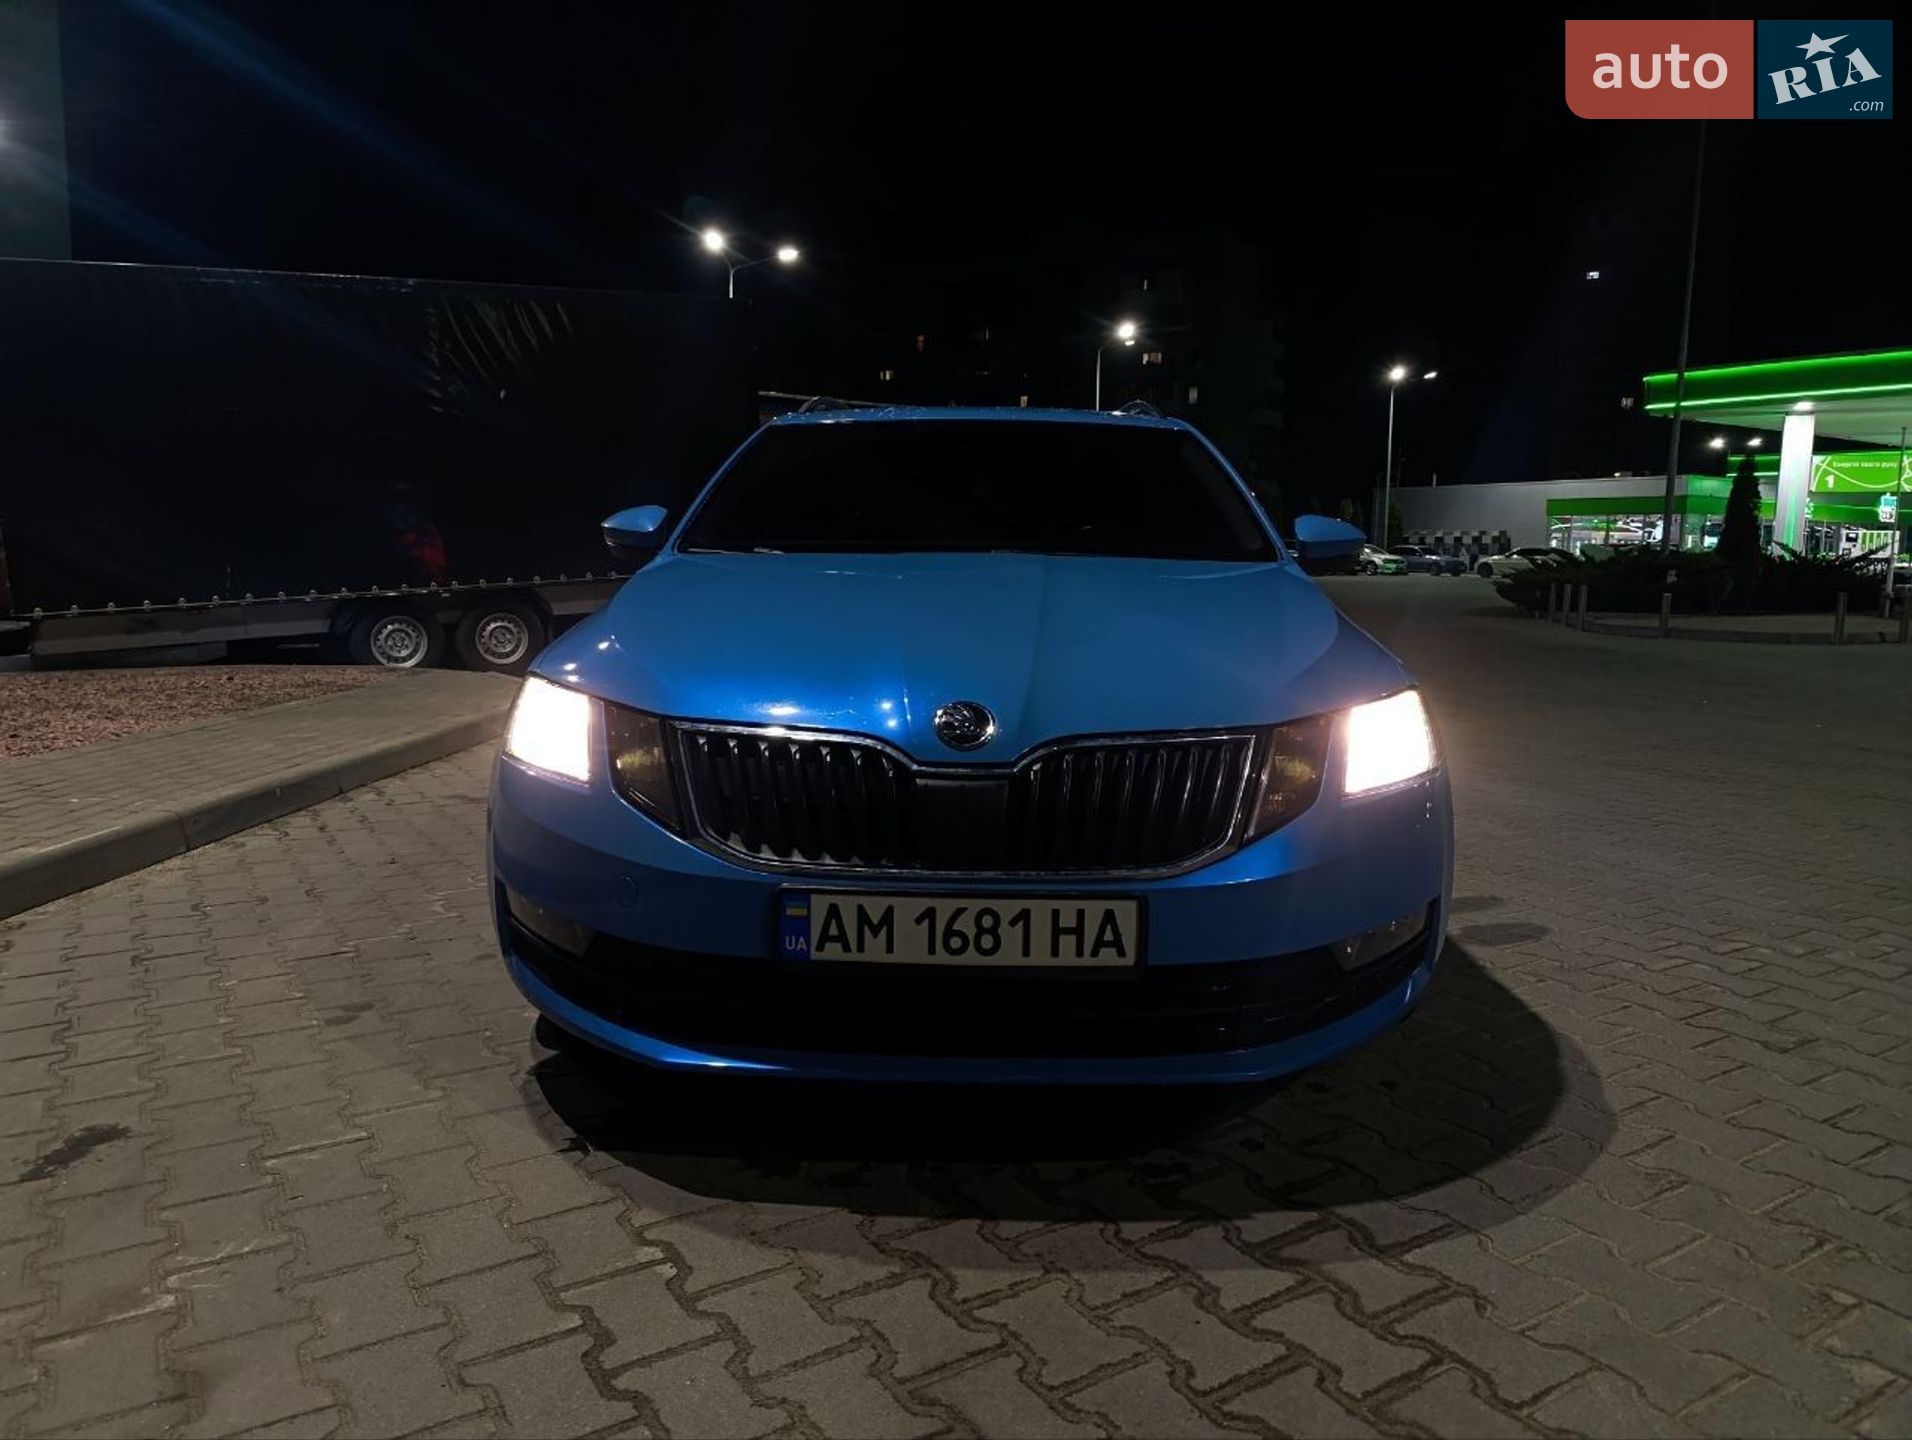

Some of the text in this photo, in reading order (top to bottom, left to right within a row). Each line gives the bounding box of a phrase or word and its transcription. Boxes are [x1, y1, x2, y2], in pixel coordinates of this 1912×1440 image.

[1825, 474, 1835, 489] 1
[814, 902, 1127, 958] AM 1681 HA
[785, 933, 808, 951] UA
